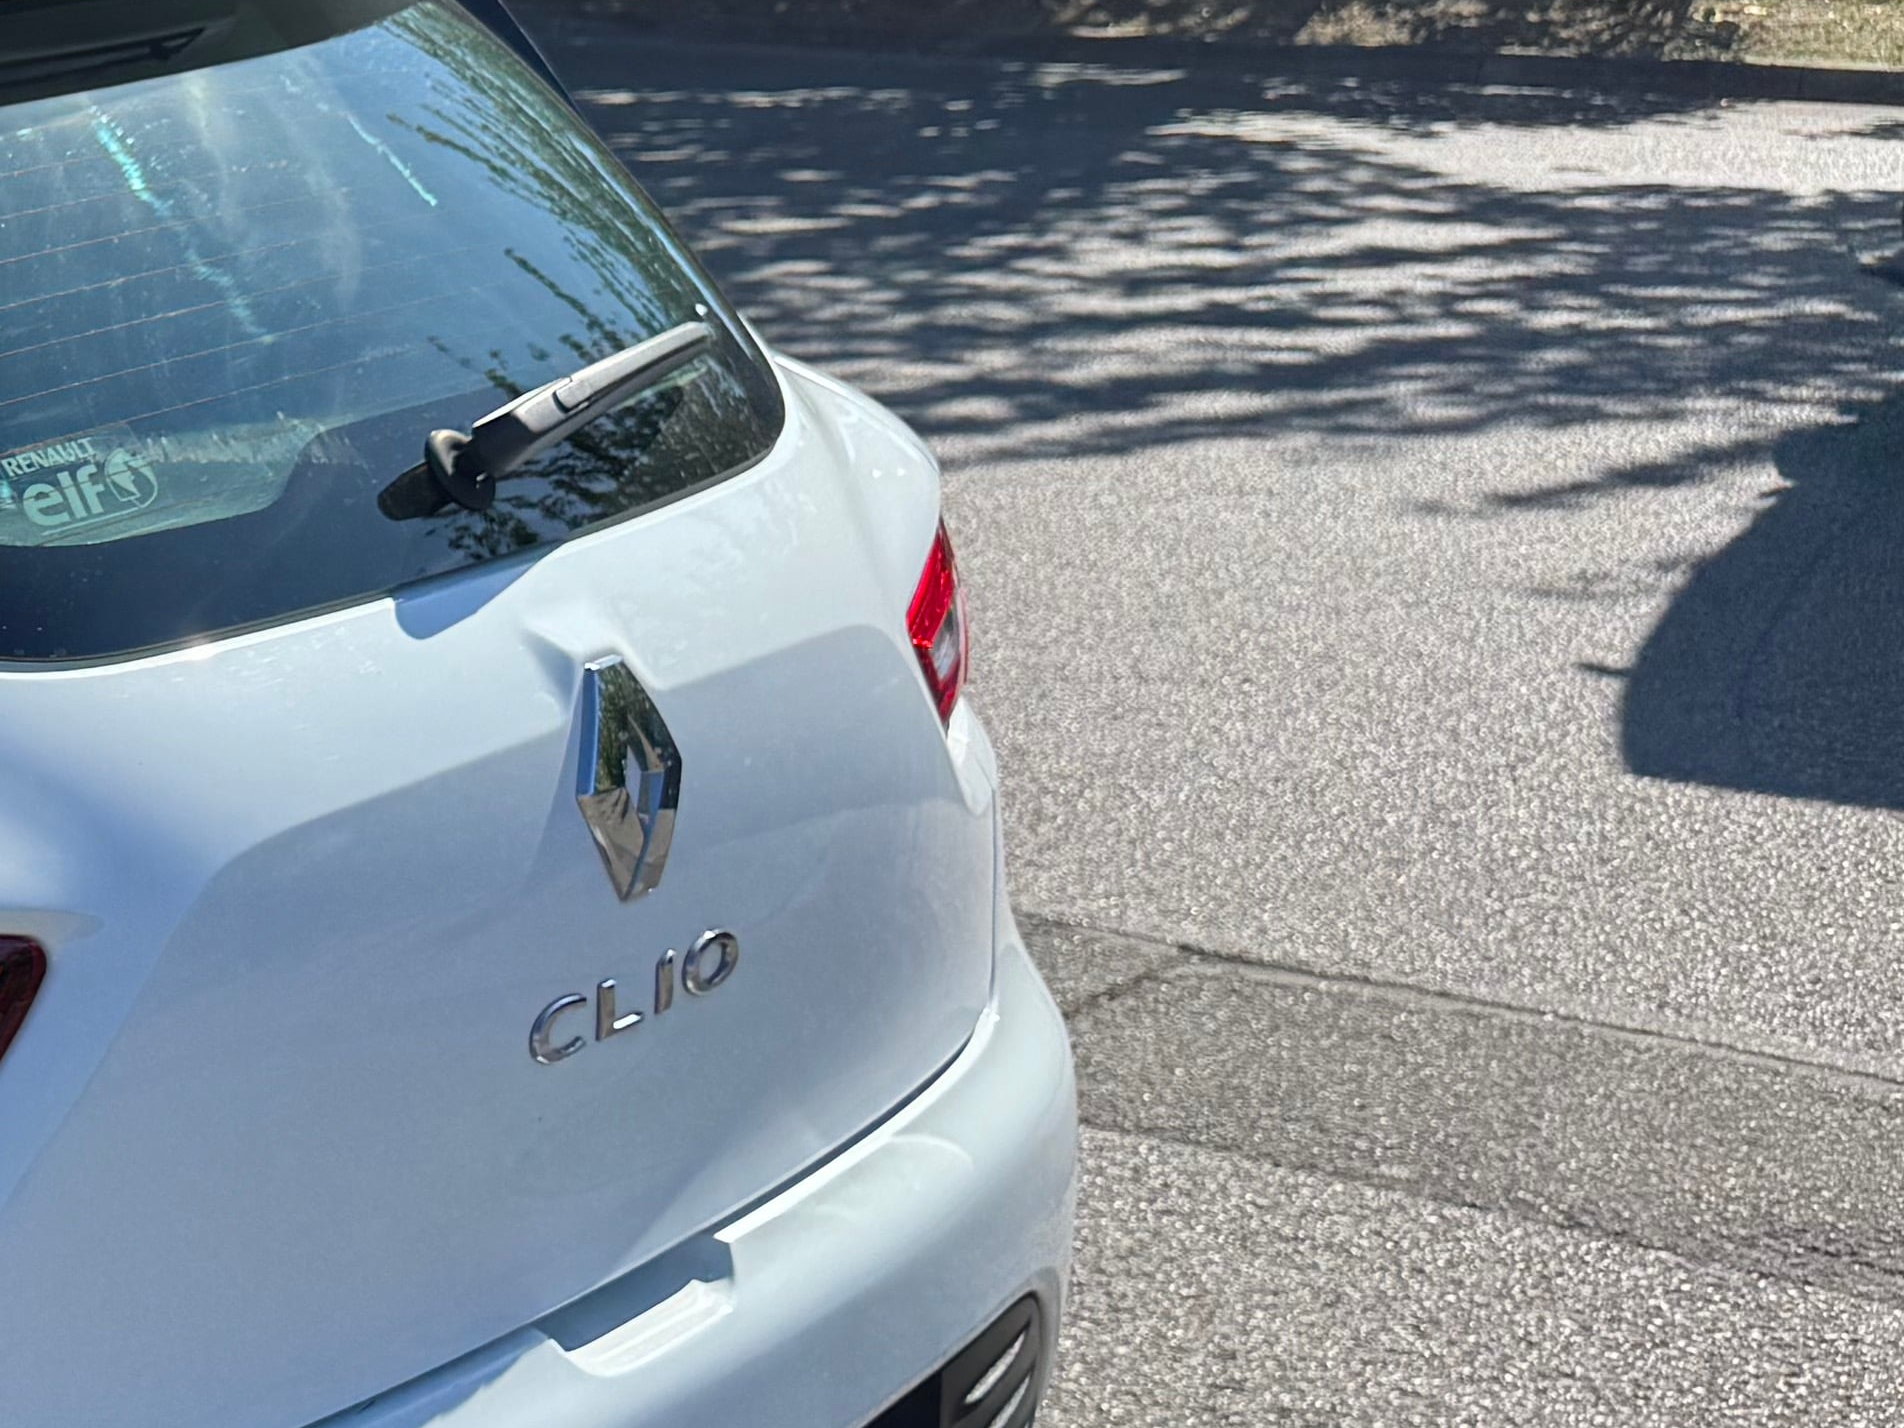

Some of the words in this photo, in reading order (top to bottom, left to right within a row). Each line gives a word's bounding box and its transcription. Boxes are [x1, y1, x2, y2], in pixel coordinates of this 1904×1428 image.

[1, 437, 96, 477] RENAULT
[22, 463, 106, 527] elf
[529, 927, 740, 1065] CLIO
